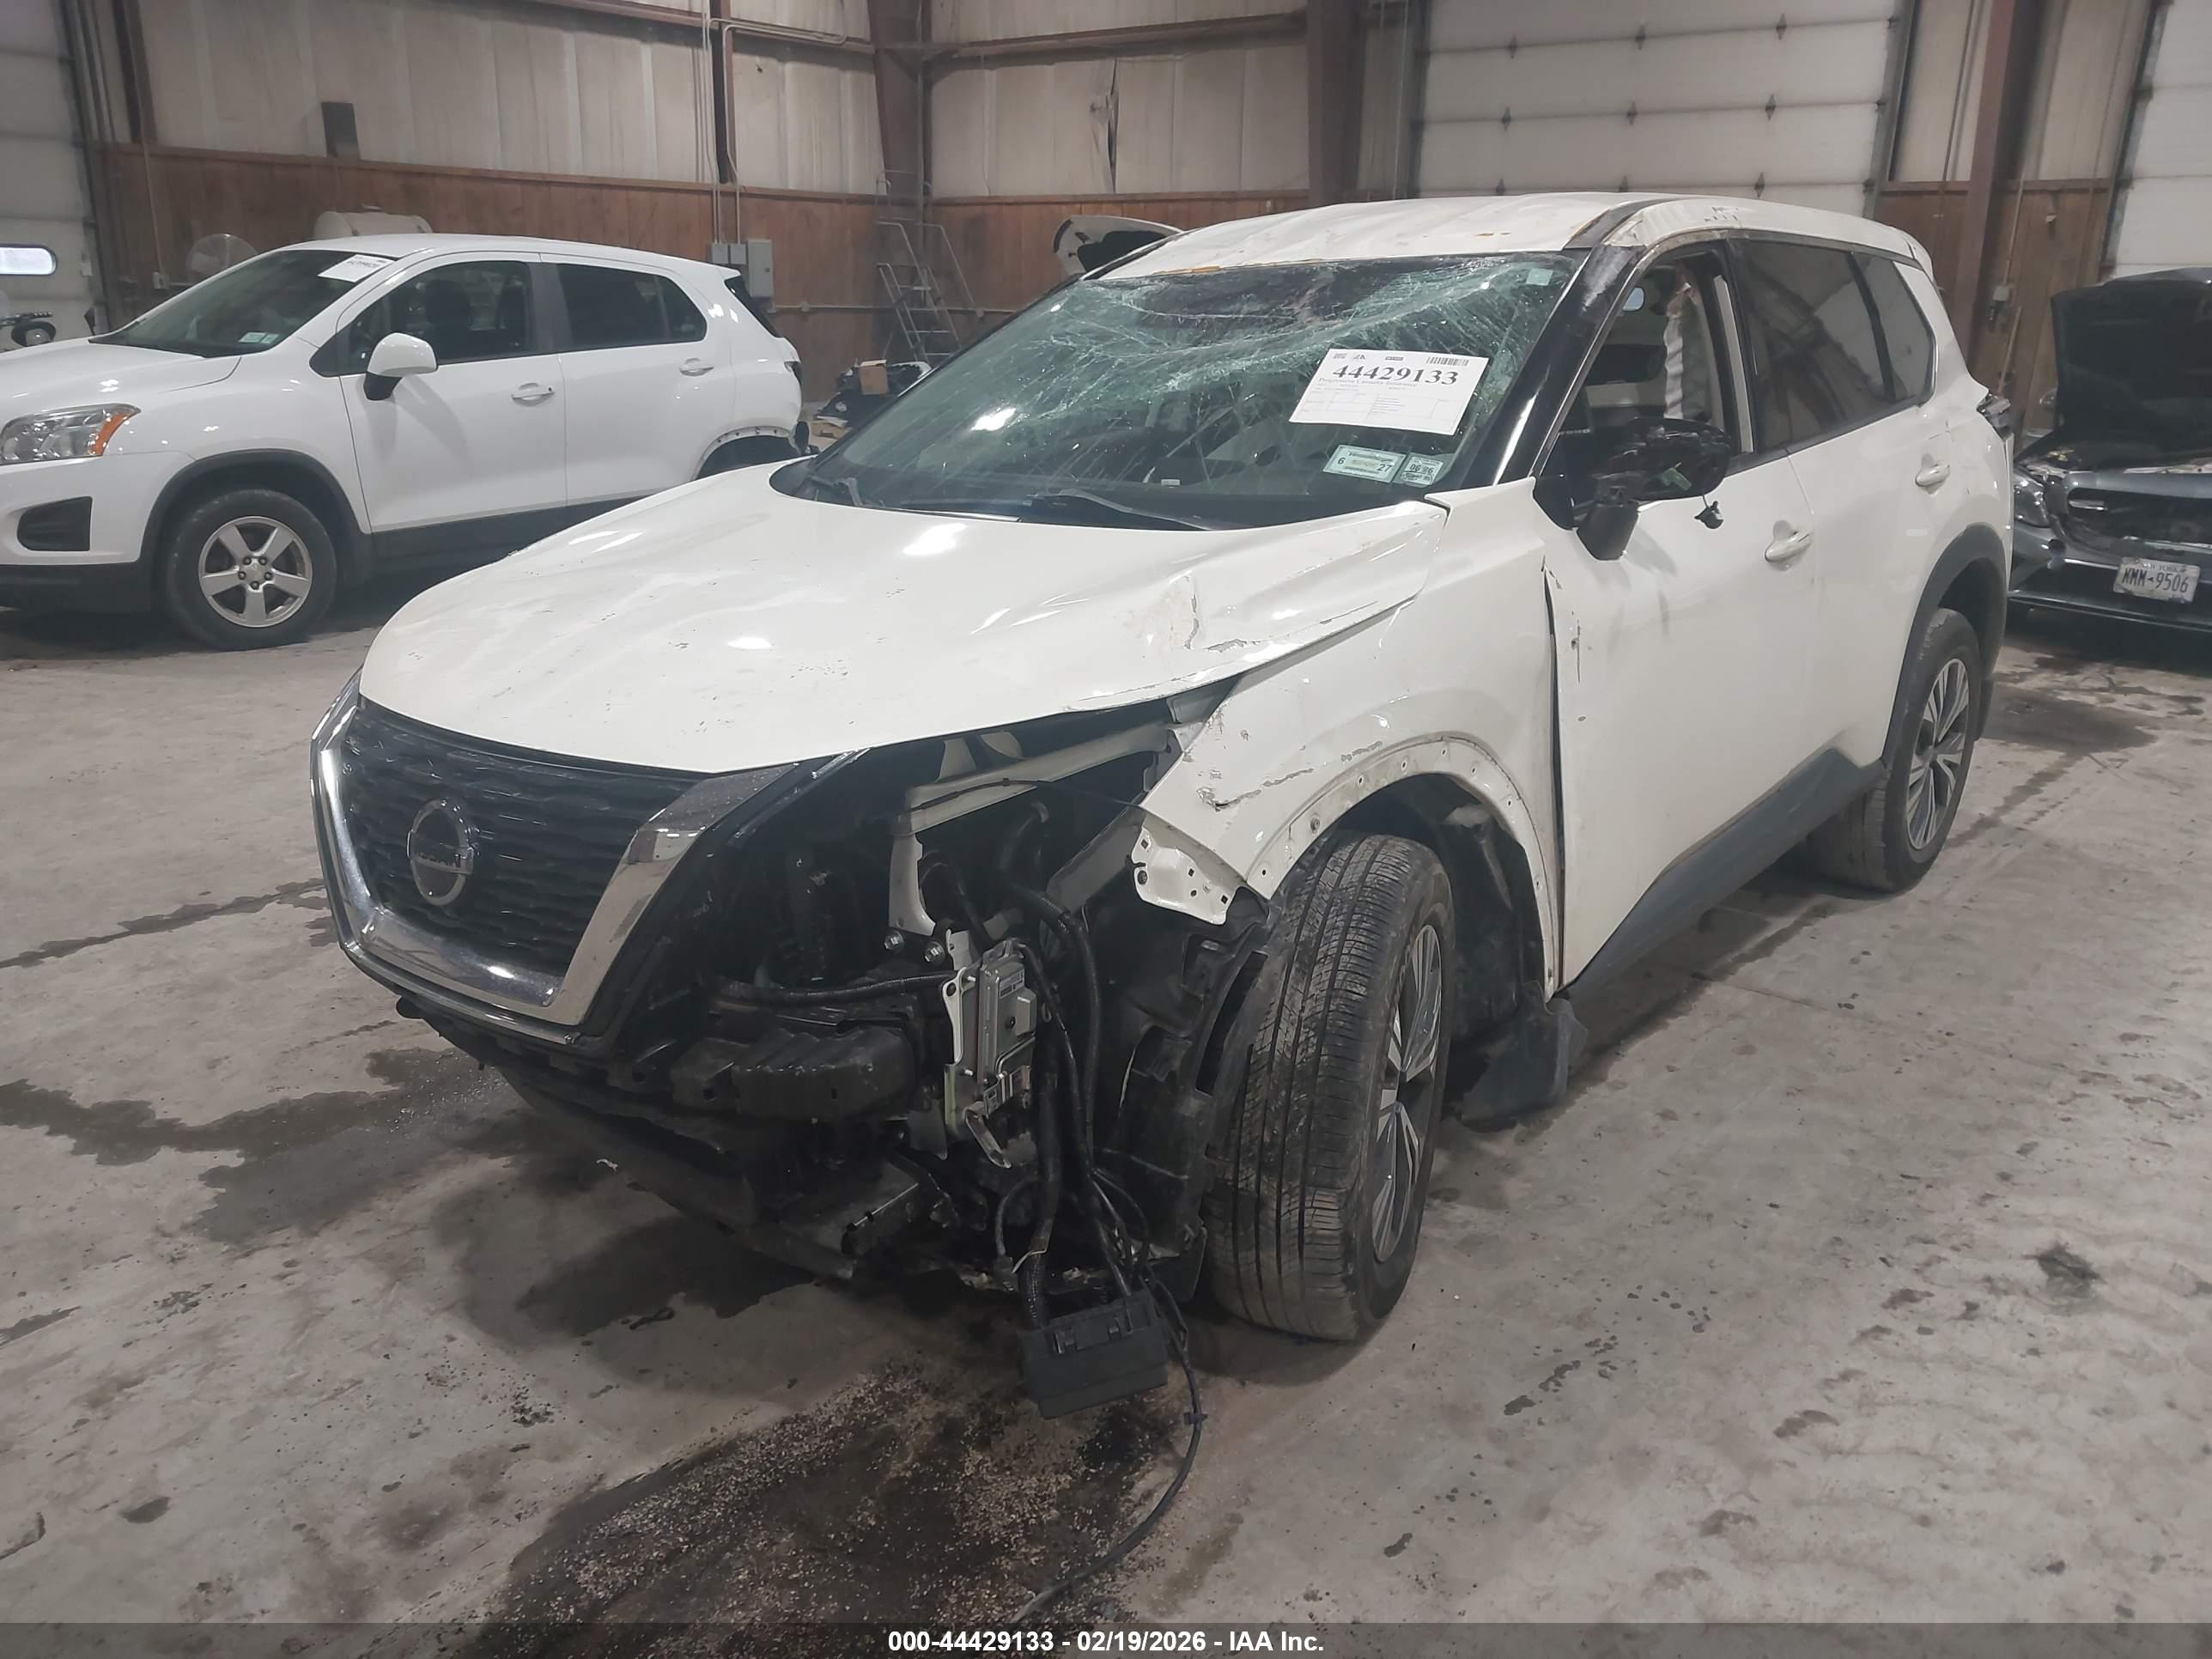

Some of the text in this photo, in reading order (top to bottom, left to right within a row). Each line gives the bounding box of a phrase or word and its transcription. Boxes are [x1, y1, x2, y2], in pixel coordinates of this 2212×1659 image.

[1333, 364, 1459, 386] 44429133
[1376, 464, 1393, 472] 27
[2155, 572, 2189, 592] 9506
